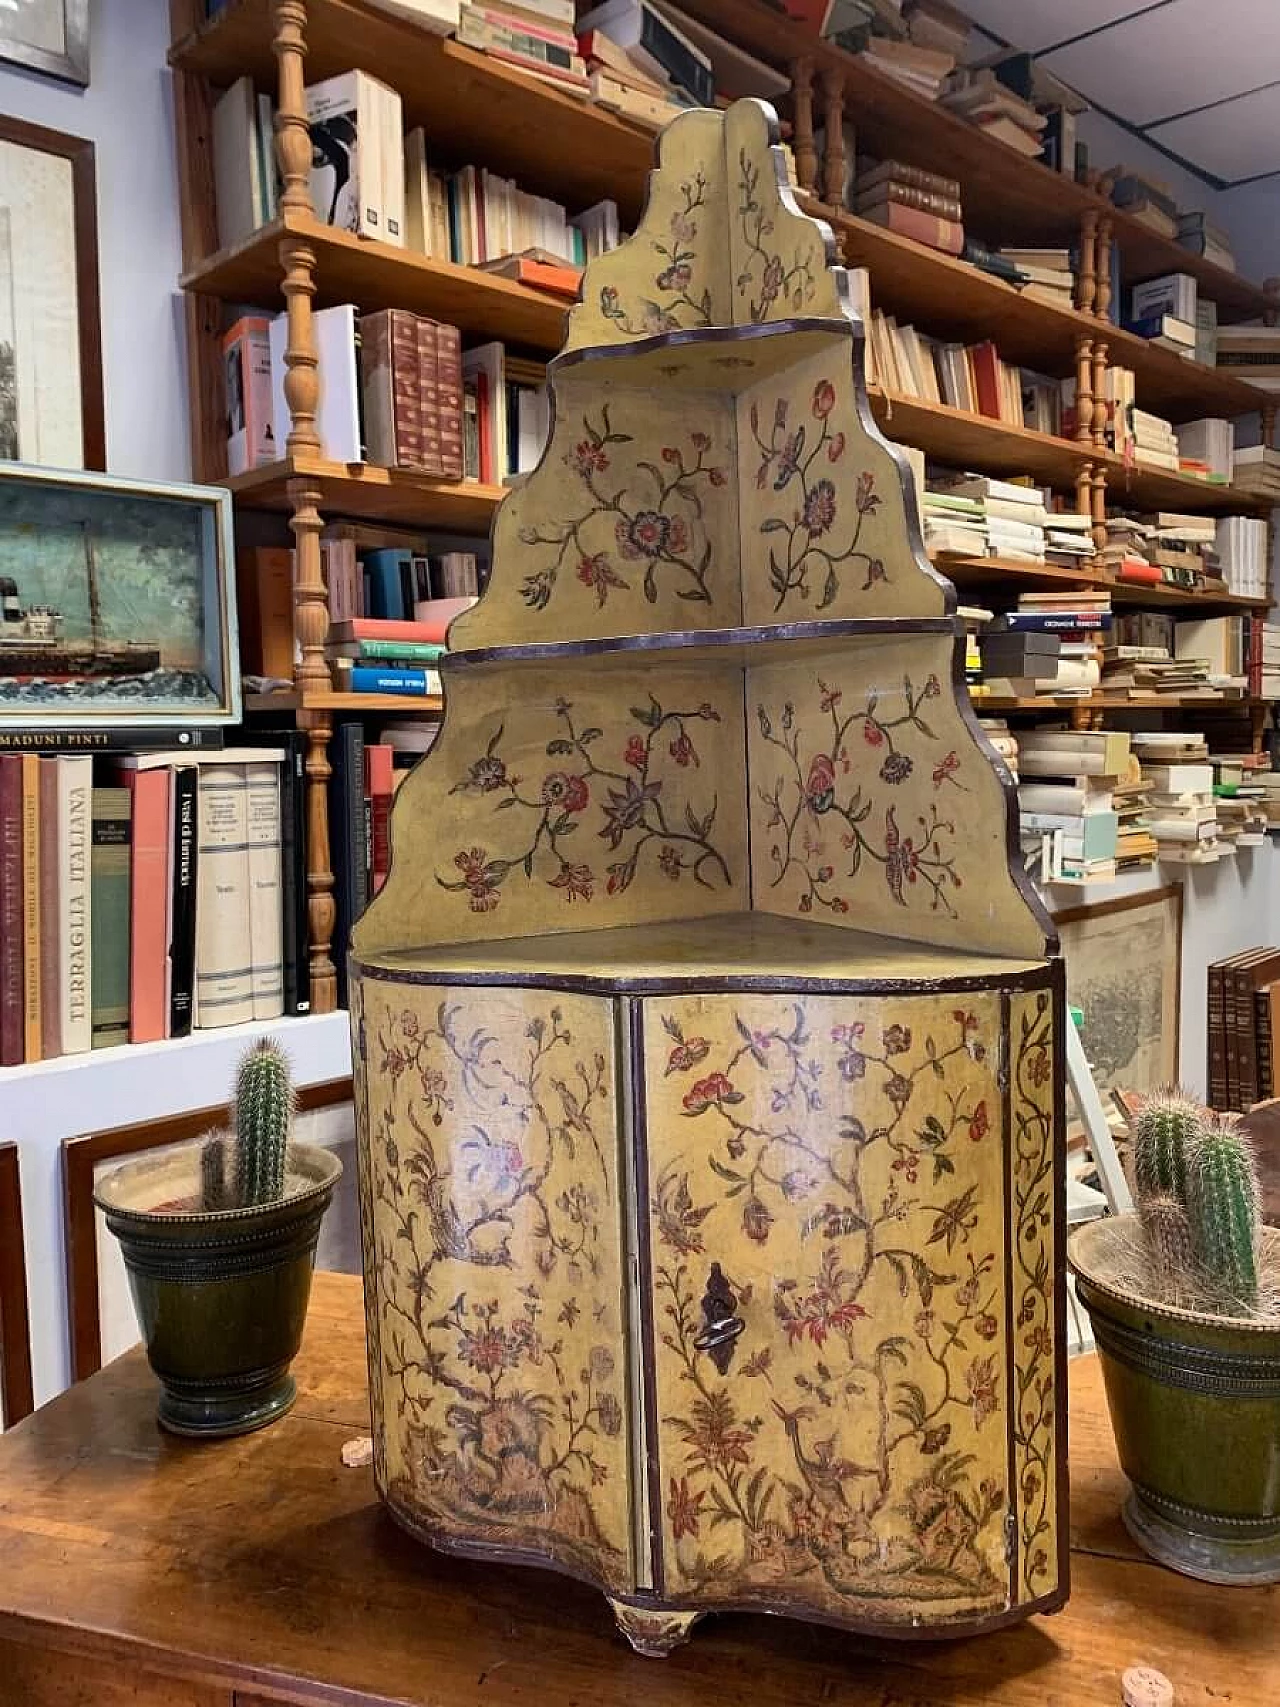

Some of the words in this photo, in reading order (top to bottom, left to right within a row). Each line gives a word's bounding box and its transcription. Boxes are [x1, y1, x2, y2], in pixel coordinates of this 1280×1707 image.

[68, 734, 108, 745] PINTI
[69, 787, 85, 882] ITALIANA
[69, 895, 85, 1022] TERRAGLIA
